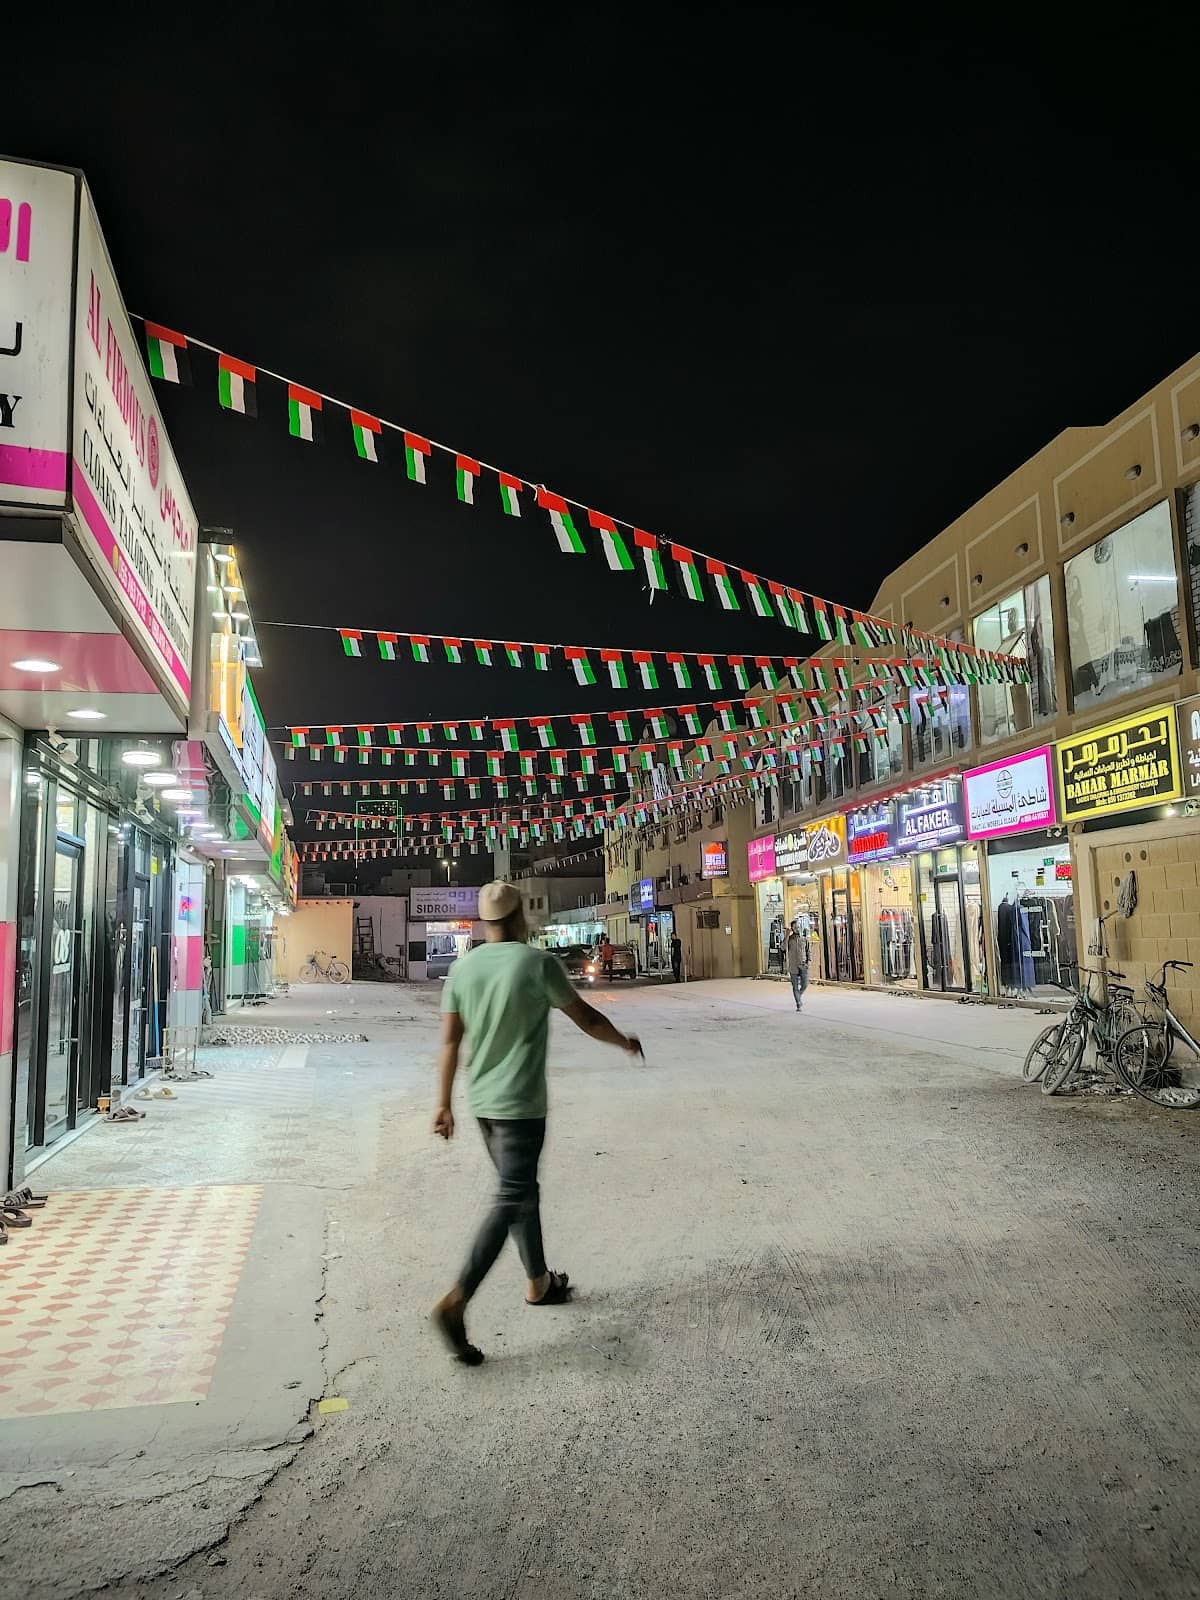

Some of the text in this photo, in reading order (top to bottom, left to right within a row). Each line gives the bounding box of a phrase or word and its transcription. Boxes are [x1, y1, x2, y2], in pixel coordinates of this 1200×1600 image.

[87, 267, 146, 468] AL FIRDOUS
[83, 429, 117, 524] CLOAKS
[119, 503, 154, 600] TAILORING
[1066, 775, 1107, 799] BAHAR
[1110, 760, 1169, 789] MARMAR
[906, 818, 917, 836] AL
[919, 809, 950, 832] FAKER
[416, 904, 456, 914] SIDROH
